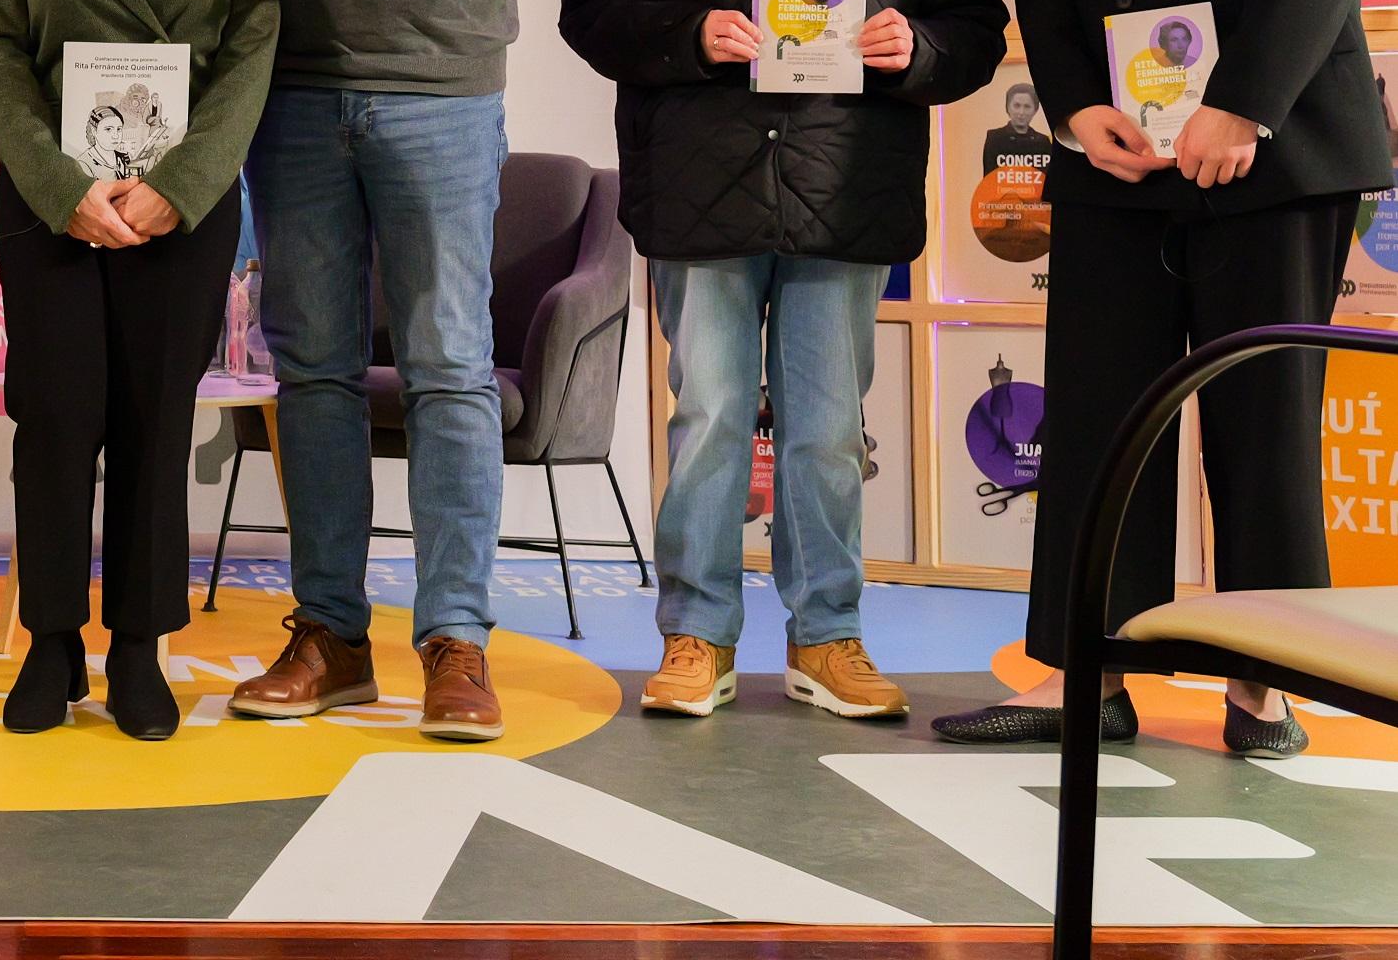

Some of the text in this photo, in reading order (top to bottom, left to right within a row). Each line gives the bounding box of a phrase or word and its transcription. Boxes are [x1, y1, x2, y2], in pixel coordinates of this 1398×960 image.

[74, 62, 178, 72] Rita Fernández Queimadelos
[996, 154, 1051, 168] CONCEP
[996, 168, 1043, 184] PÉREZ
[991, 211, 1022, 220] Galicia
[1014, 443, 1042, 457] JUA
